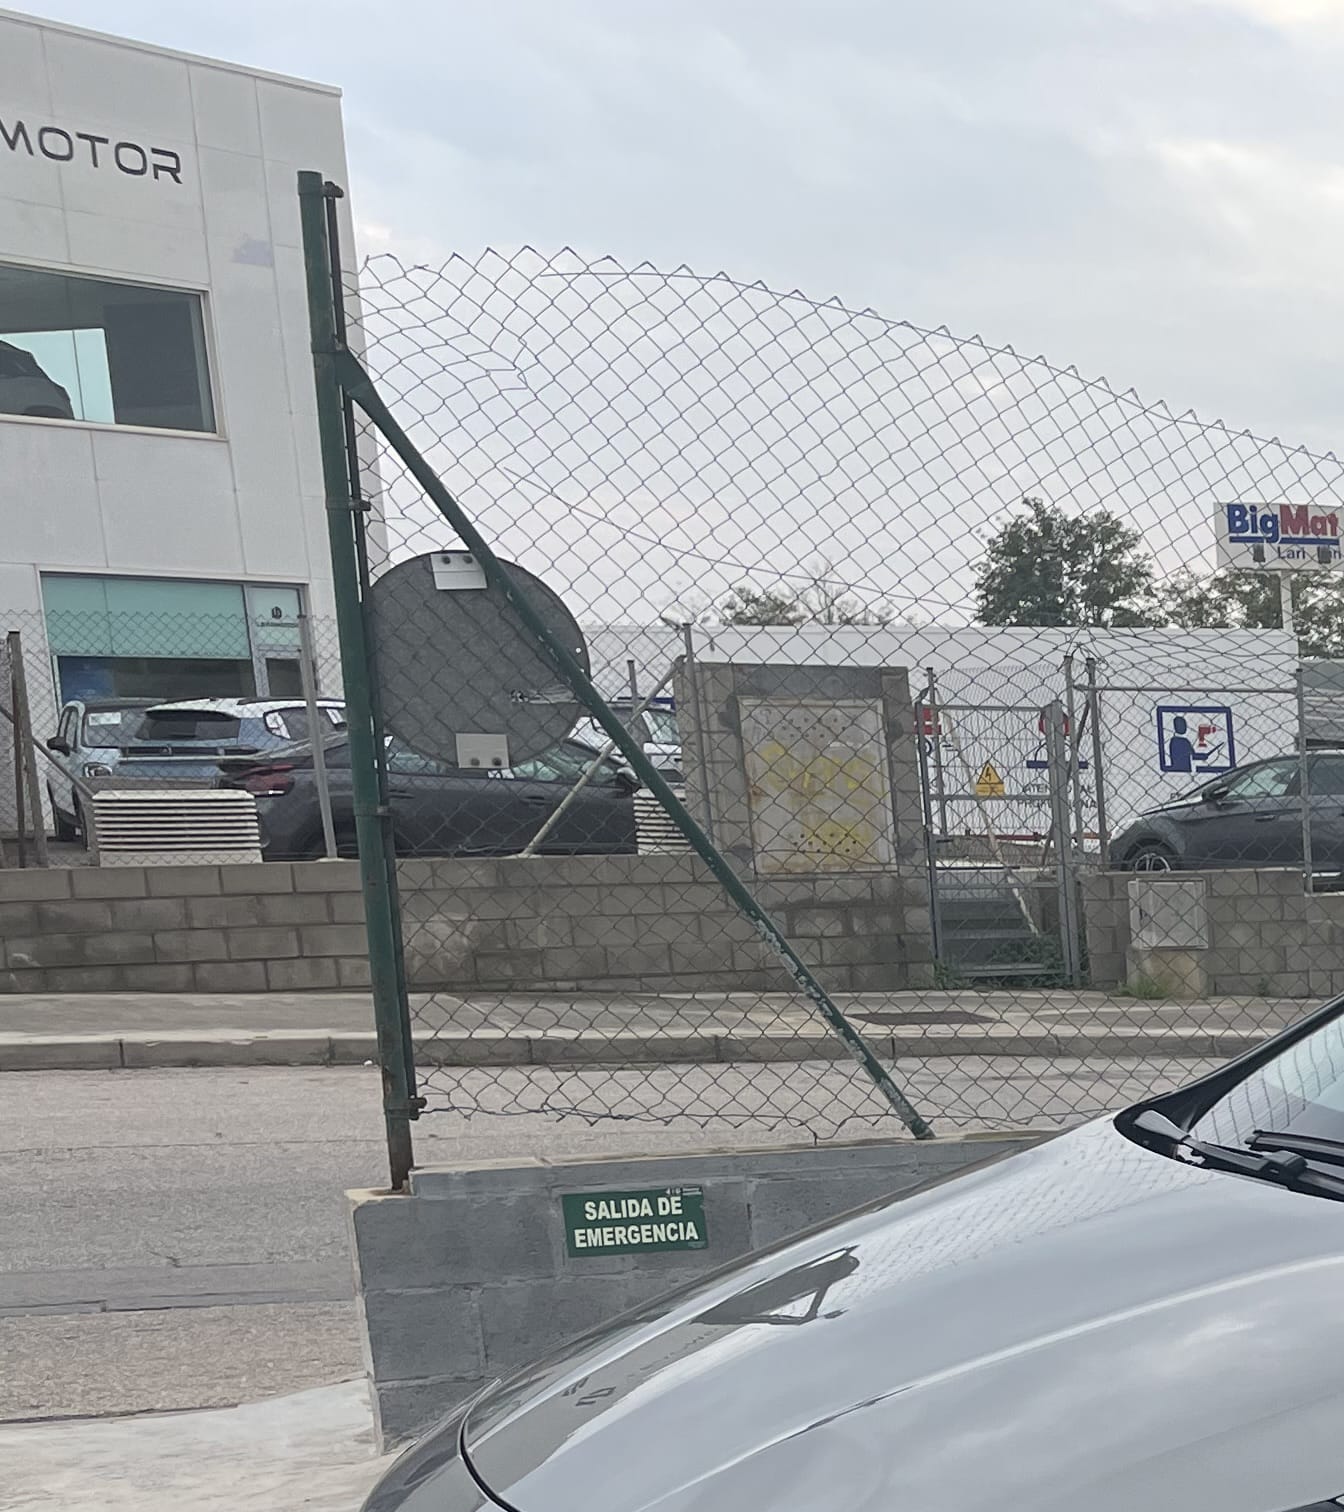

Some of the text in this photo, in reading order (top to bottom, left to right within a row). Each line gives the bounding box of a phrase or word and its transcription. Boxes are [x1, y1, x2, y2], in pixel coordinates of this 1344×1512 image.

[0, 119, 183, 184] MOTOR
[1227, 503, 1339, 542] BigMat
[584, 1196, 683, 1221] SALIDA DE
[574, 1221, 699, 1248] EMERGENCIA
